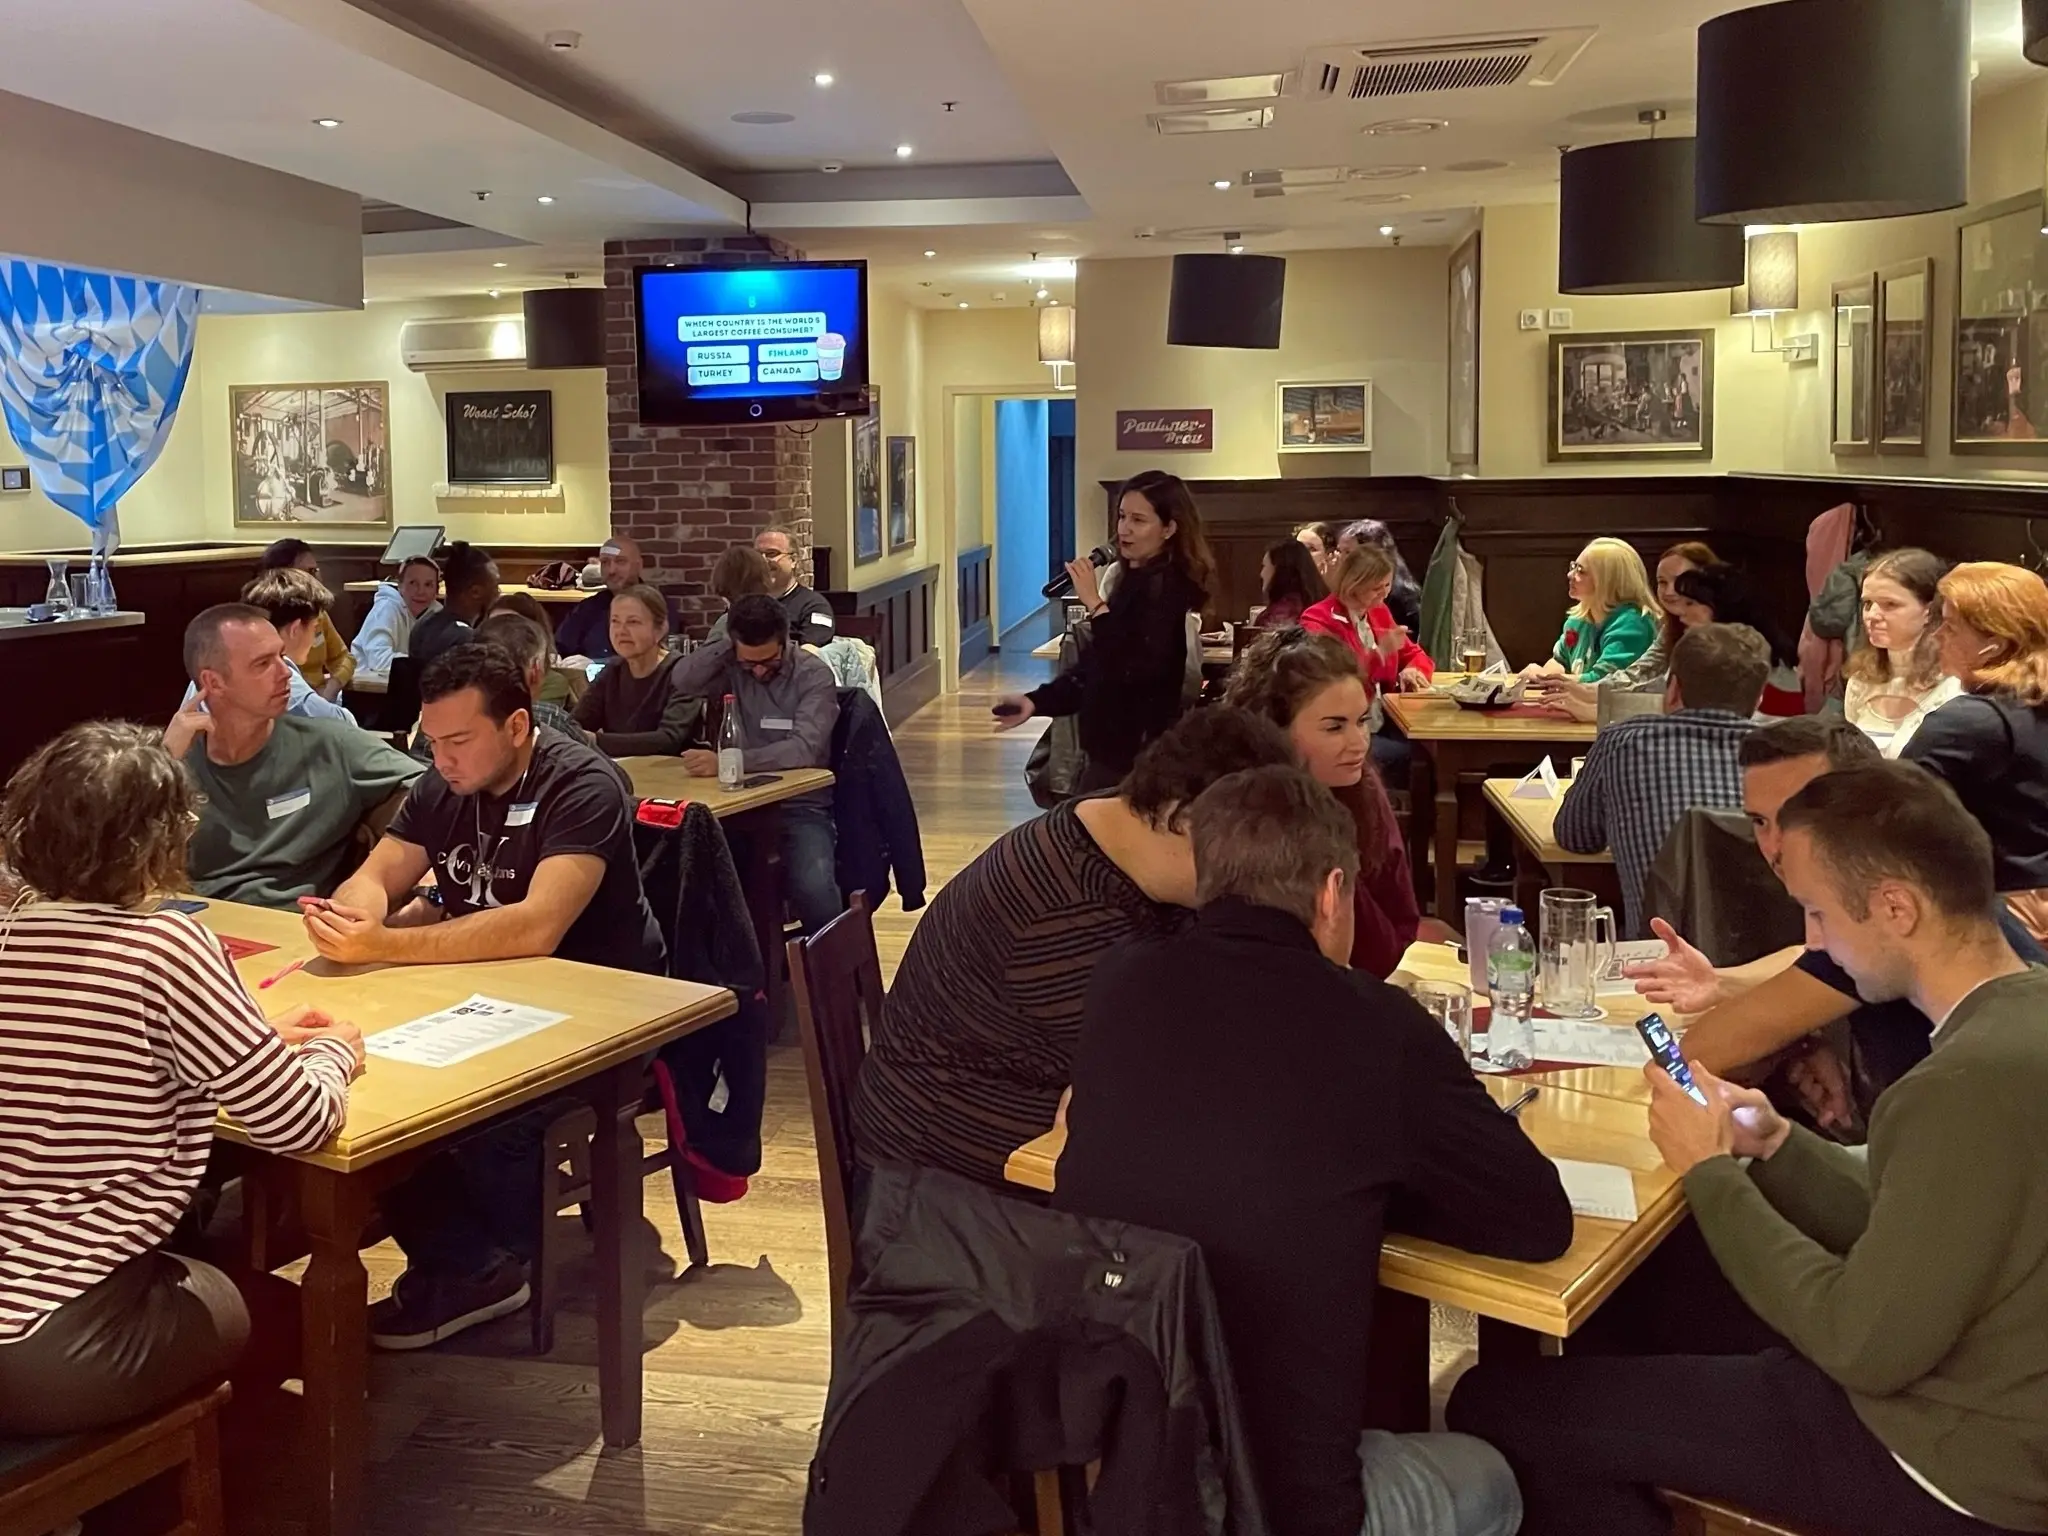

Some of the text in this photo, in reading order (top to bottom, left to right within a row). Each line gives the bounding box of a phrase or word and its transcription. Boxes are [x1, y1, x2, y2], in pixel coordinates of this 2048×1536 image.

[684, 320, 714, 328] WHICH
[716, 319, 755, 327] COUNTRY
[785, 316, 821, 324] WORLDS
[692, 326, 814, 338] LARGEST COFFEE CONSUMER?
[697, 352, 732, 360] RUSSIA
[768, 348, 809, 357] FINLAND
[698, 369, 733, 378] TURKEY
[762, 366, 802, 375] CANADA
